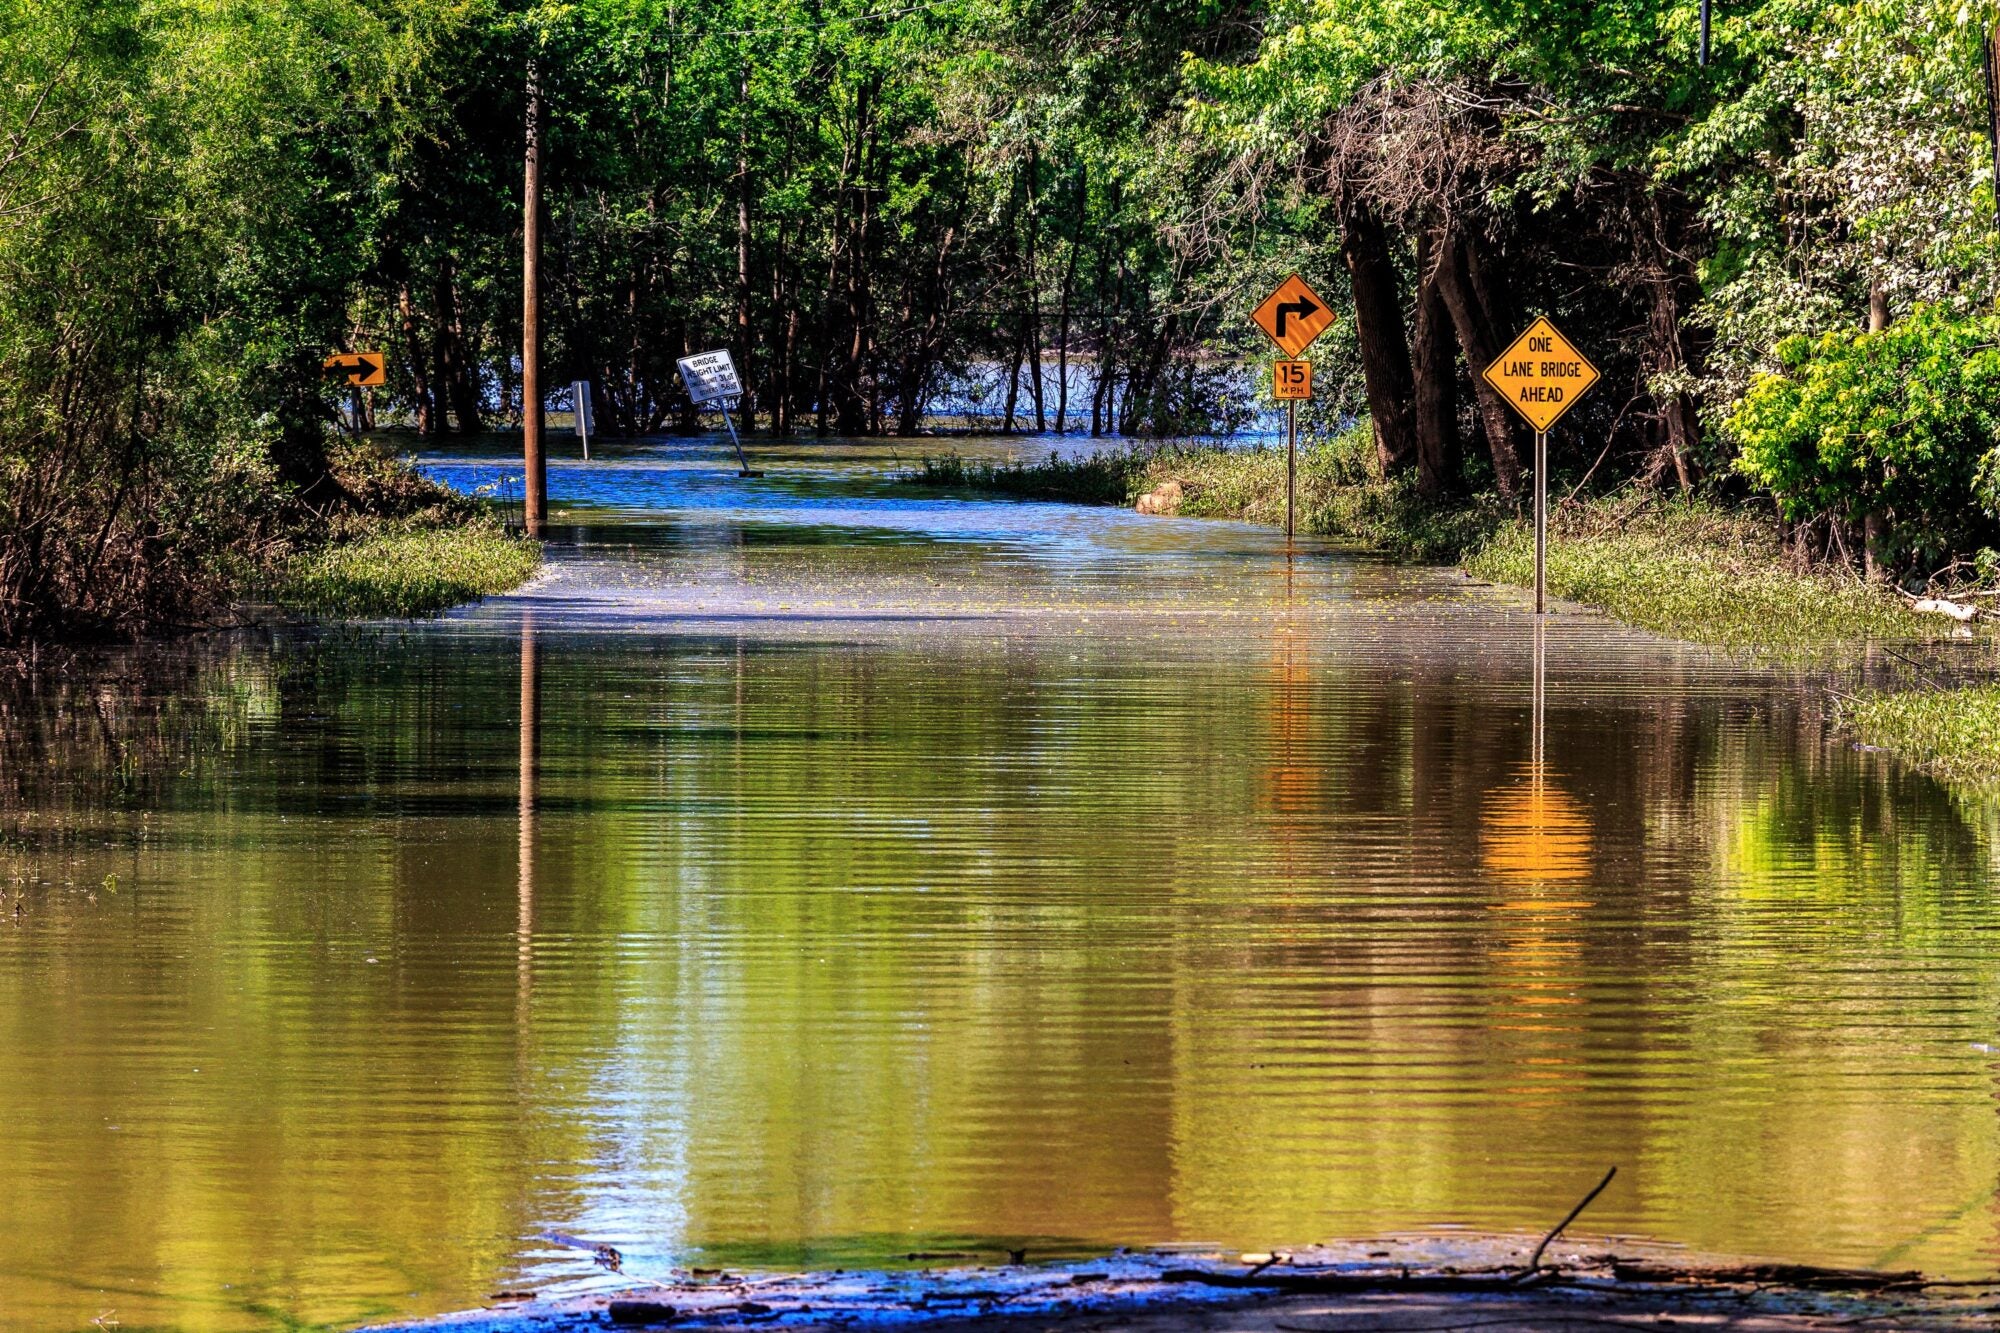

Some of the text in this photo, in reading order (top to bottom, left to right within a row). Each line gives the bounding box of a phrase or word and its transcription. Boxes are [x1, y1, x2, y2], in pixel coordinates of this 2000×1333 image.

[1529, 337, 1553, 352] ONE
[692, 356, 718, 367] BRIDGE
[687, 364, 731, 378] WEIGHT LIMIT
[1281, 366, 1305, 384] 15
[1504, 362, 1581, 377] LANE BRIDGE
[1520, 387, 1563, 402] AHEAD
